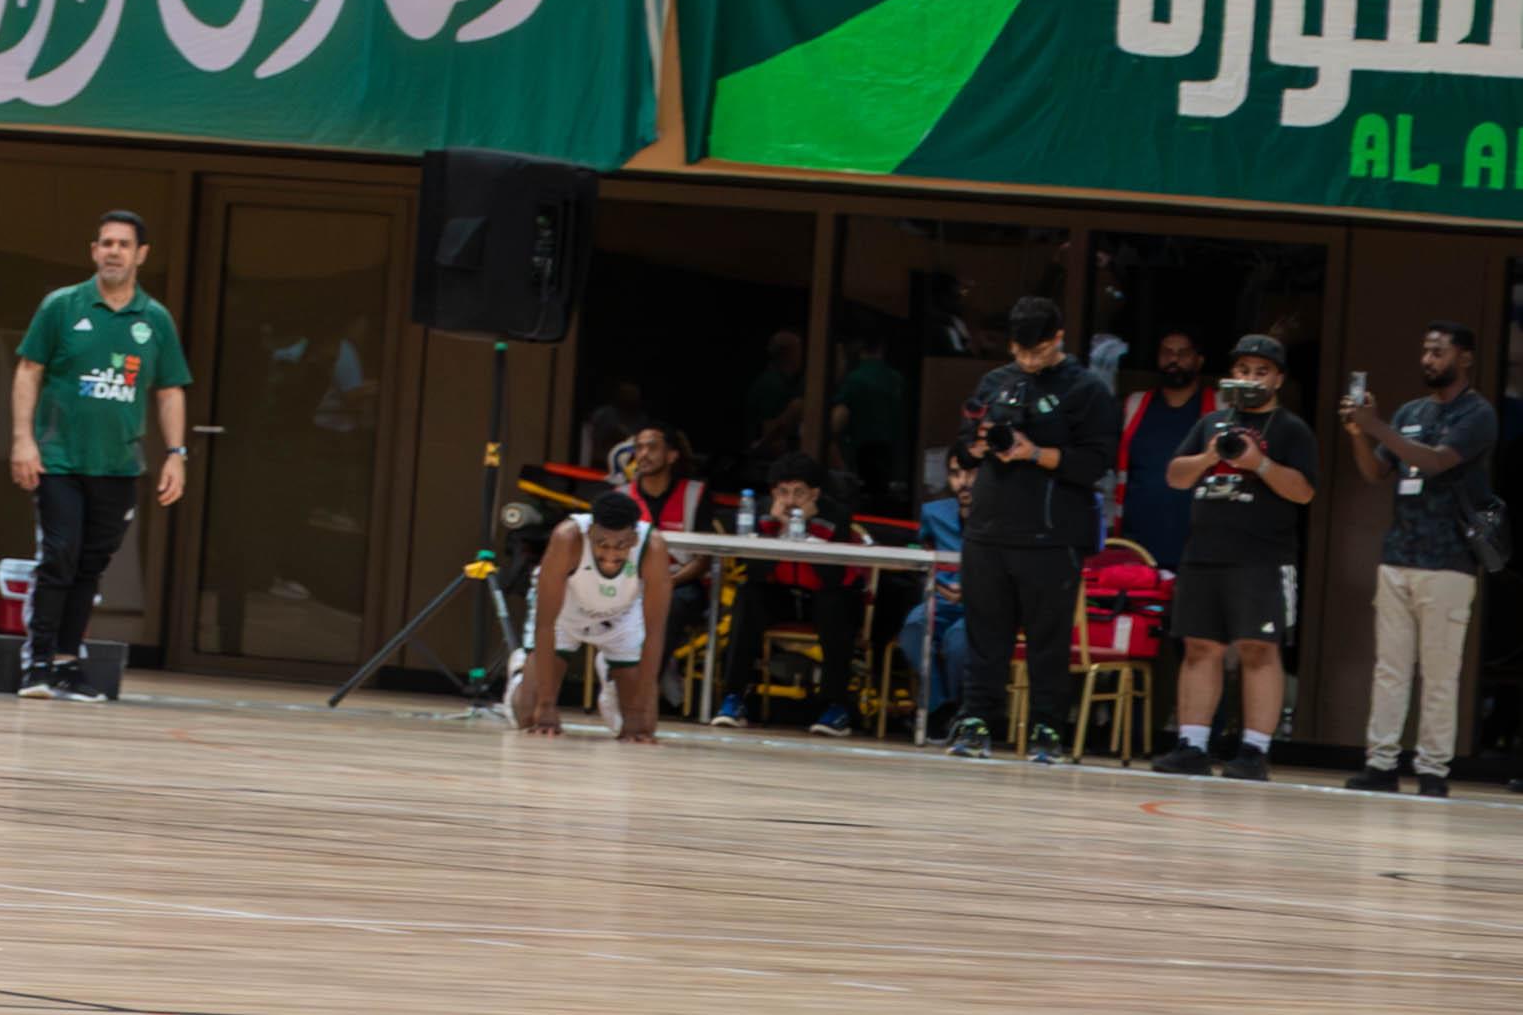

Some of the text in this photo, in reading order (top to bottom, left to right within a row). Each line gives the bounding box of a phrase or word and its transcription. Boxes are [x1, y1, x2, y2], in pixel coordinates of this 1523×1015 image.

[1349, 113, 1523, 192] AL A
[92, 383, 136, 403] DAN
